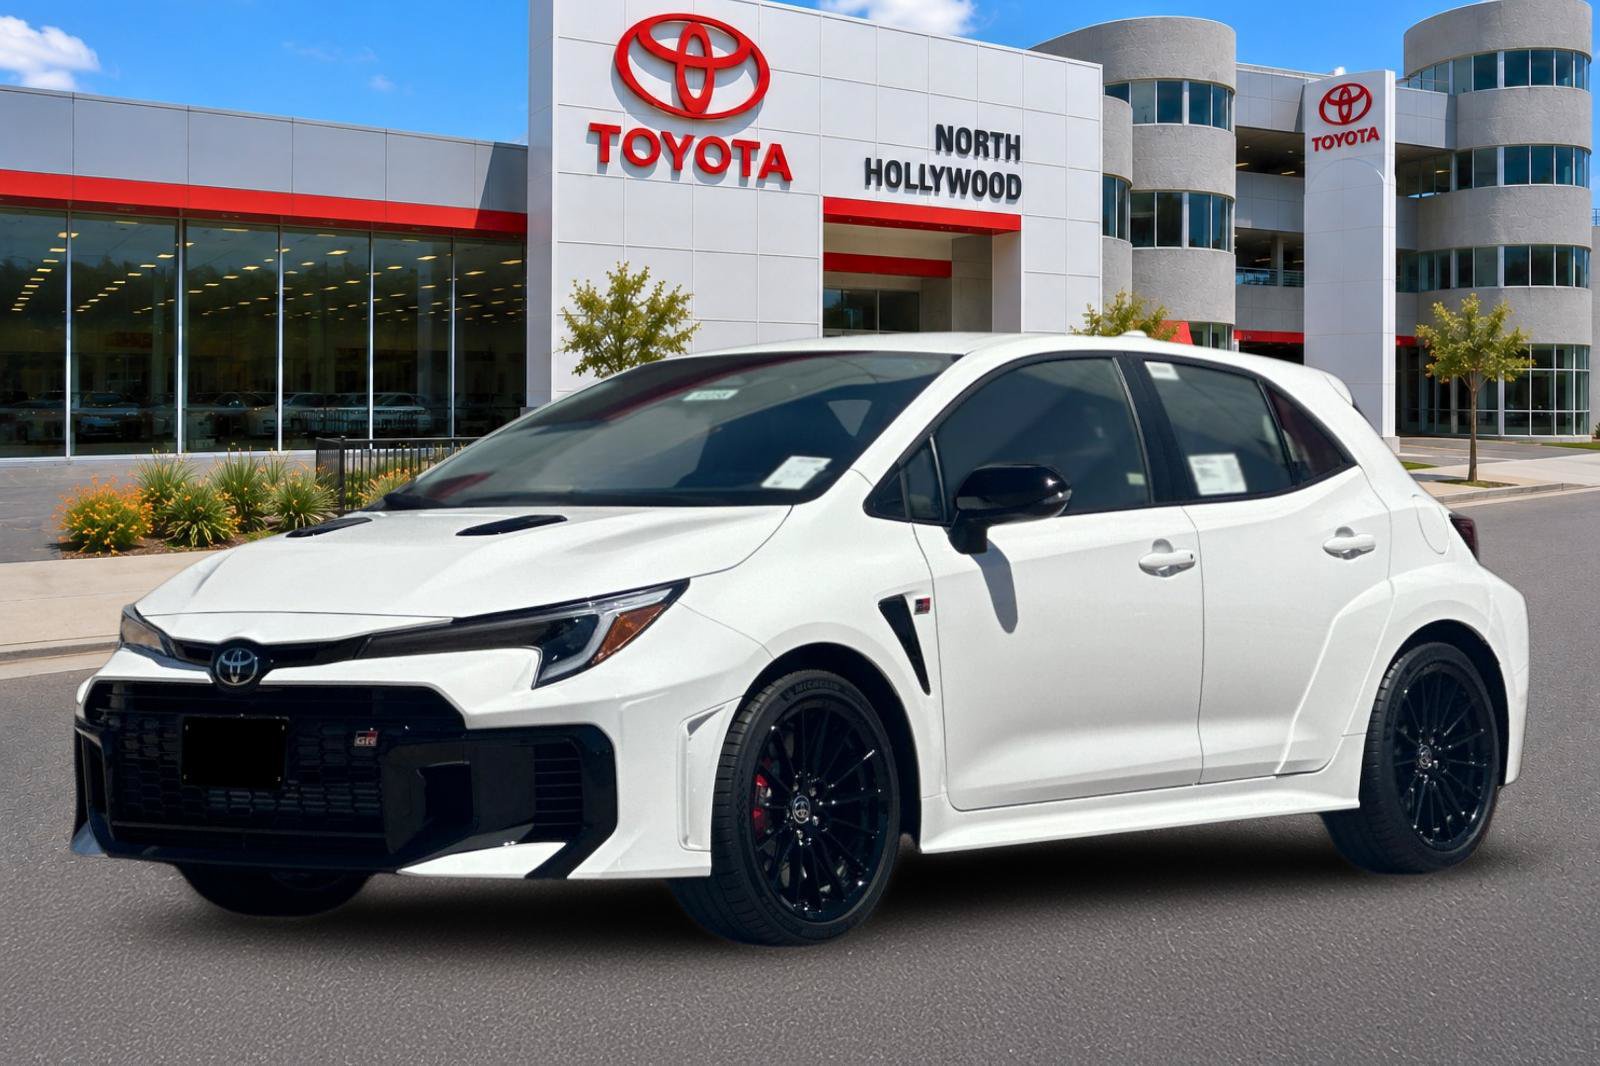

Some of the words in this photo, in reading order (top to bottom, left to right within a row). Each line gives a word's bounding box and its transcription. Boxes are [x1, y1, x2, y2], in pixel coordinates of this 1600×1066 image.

[588, 123, 793, 182] TOYOTA
[936, 124, 1021, 161] NORTH
[1312, 126, 1380, 152] TOYOTA
[865, 158, 1022, 200] HOLLYWOOD
[356, 736, 375, 746] GR
